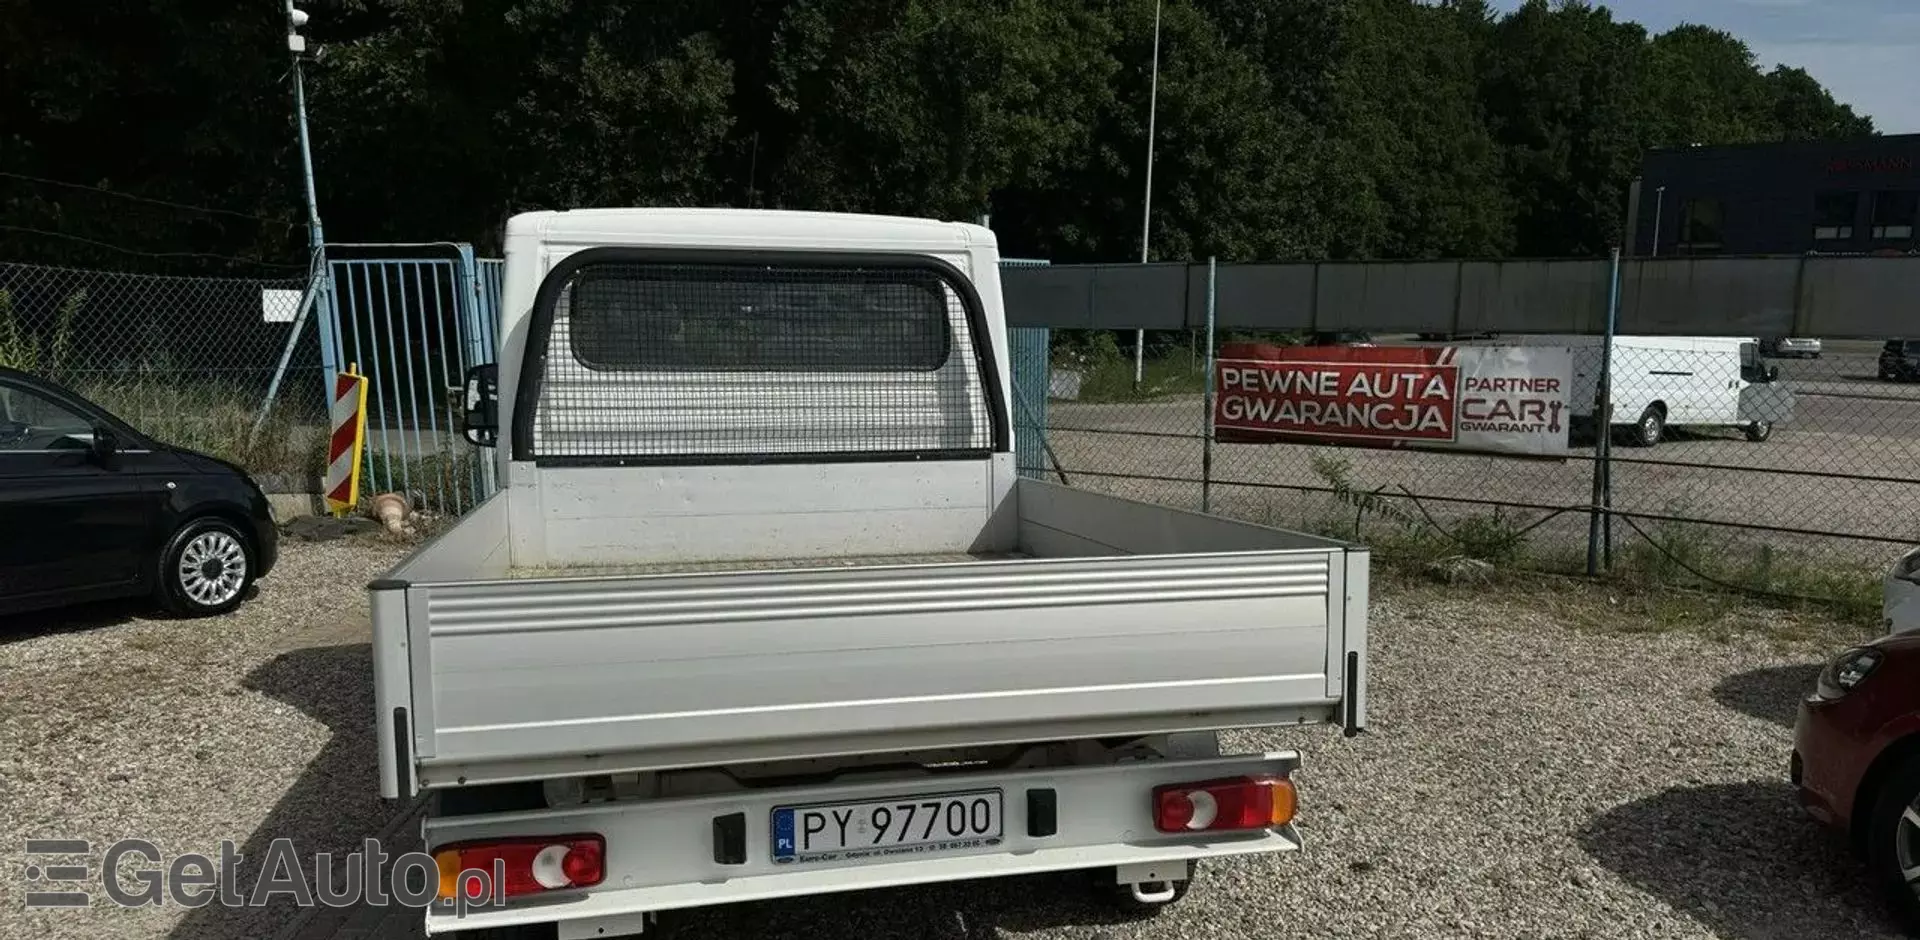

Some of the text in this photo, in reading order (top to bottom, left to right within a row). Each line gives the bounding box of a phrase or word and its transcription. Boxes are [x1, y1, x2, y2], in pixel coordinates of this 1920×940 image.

[1221, 367, 1450, 399] PEWNE AUTA
[1465, 377, 1560, 393] PARTNER
[1222, 395, 1448, 433] GWARANCJA
[1461, 399, 1546, 422] CAR
[1460, 422, 1546, 433] GWARANT
[803, 798, 990, 850] PY 97700
[778, 838, 793, 849] PL
